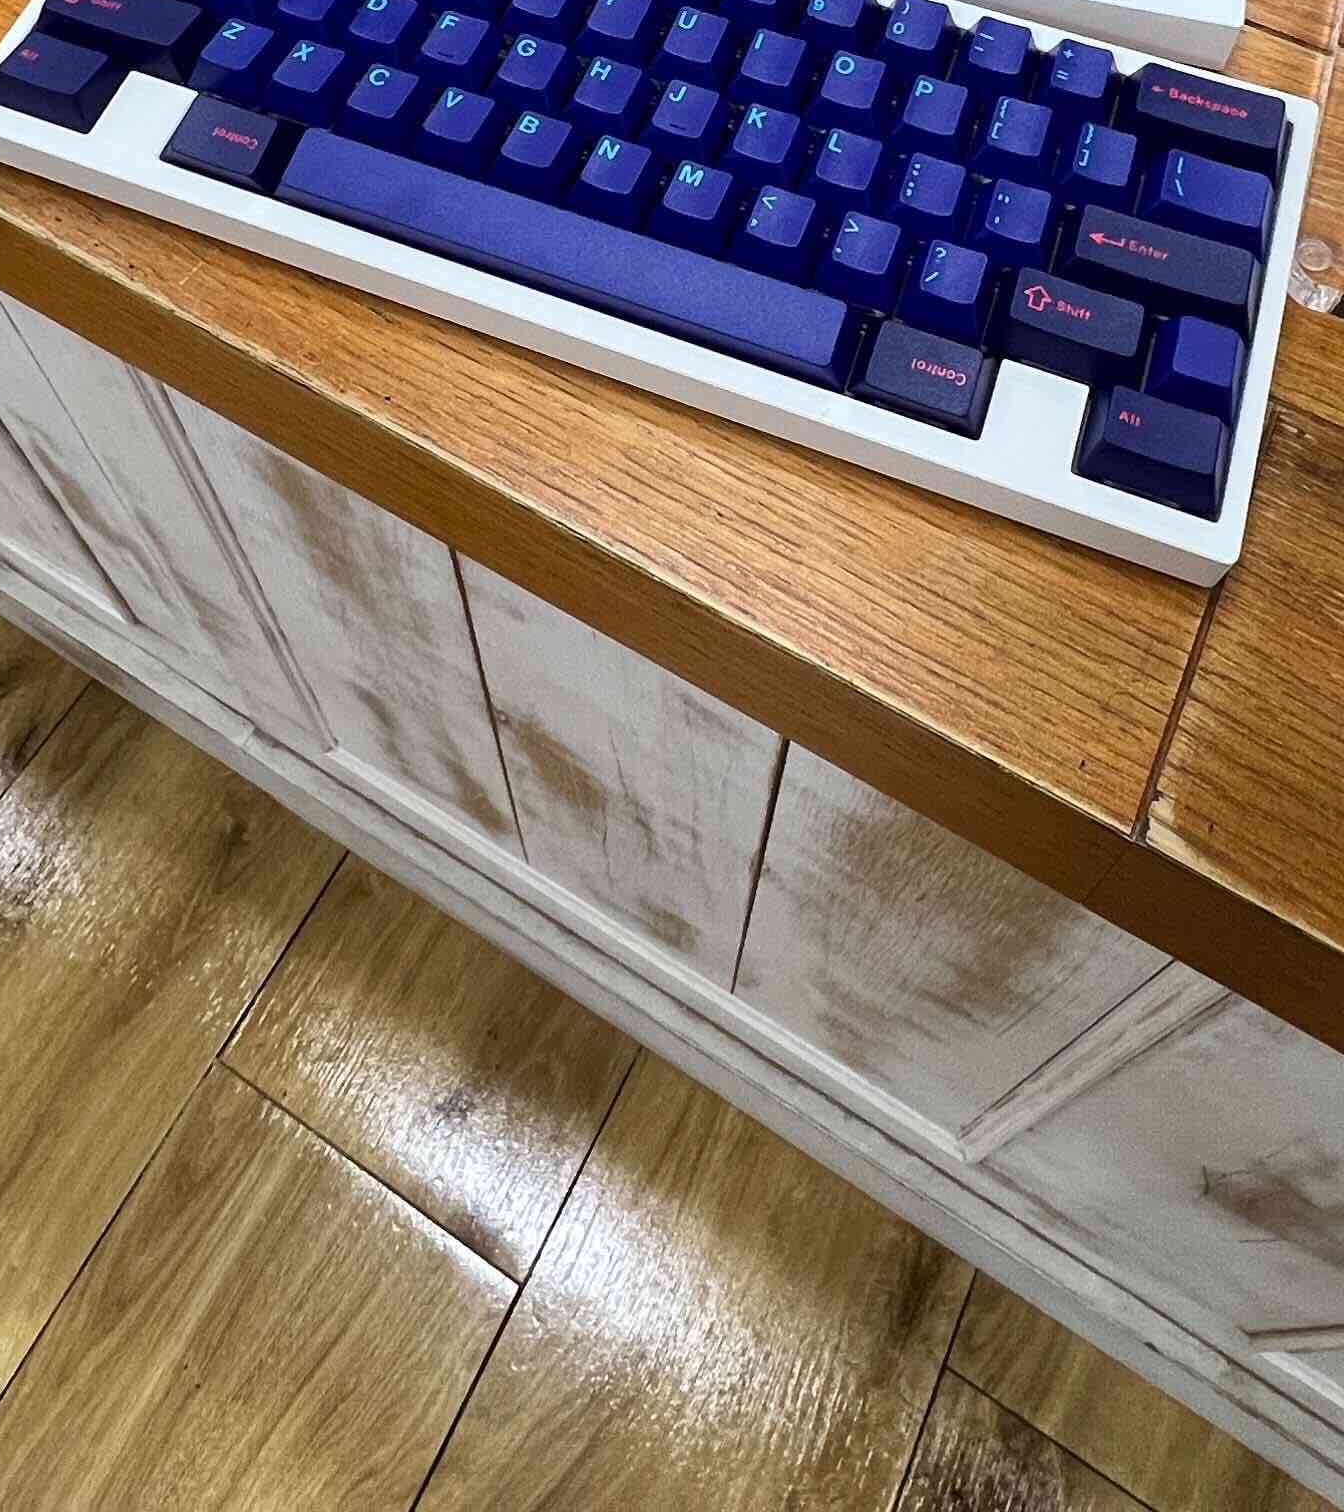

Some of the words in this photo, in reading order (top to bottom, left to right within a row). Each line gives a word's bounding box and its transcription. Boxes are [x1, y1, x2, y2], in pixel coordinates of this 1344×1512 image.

[812, 0, 825, 11] 9
[902, 1, 910, 15] )
[439, 14, 459, 30] F
[679, 11, 698, 30] U
[222, 22, 246, 40] Z
[516, 39, 537, 56] G
[755, 33, 764, 49] I
[292, 43, 314, 61] X
[1062, 47, 1075, 61] +
[589, 60, 612, 80] H
[835, 56, 855, 75] O
[369, 68, 391, 86] C
[1056, 69, 1070, 81] =
[669, 86, 688, 102] J
[914, 80, 934, 96] P
[445, 90, 464, 108] V
[1168, 87, 1249, 119] Backspace
[747, 107, 767, 128] K
[1000, 99, 1009, 118] {
[519, 115, 541, 134] B
[991, 121, 1003, 139] [
[1084, 122, 1095, 145] }
[598, 139, 621, 160] N
[828, 133, 842, 153] L
[1078, 148, 1089, 167] ]
[678, 165, 705, 187] M
[761, 196, 777, 210] <
[844, 218, 859, 234] >
[935, 247, 947, 263] ?
[1128, 238, 1169, 261] Enter
[924, 271, 939, 283] /
[1055, 300, 1092, 322] Shift
[910, 357, 968, 387] Control
[1118, 409, 1144, 427] Alt
